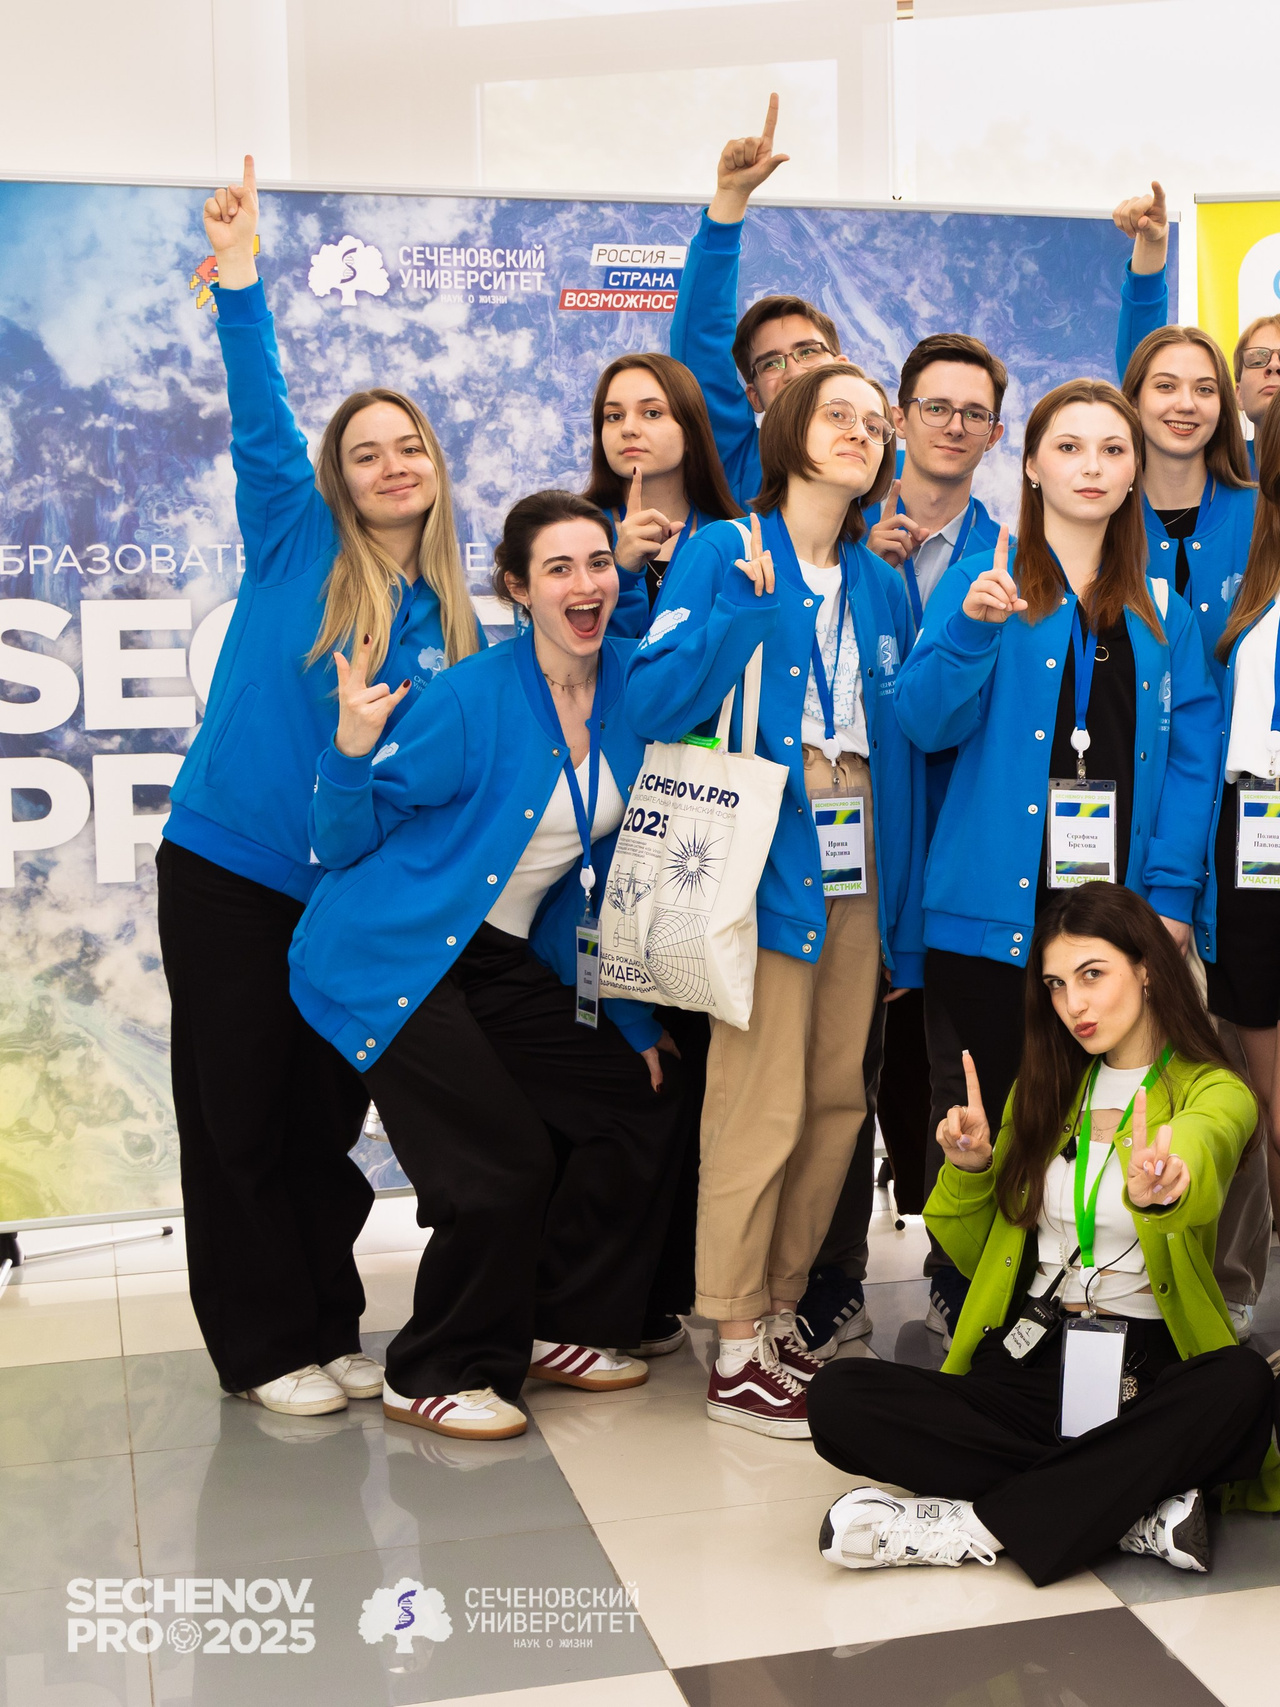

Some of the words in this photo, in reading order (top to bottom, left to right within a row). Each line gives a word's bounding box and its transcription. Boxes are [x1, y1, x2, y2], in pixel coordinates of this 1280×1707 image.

[398, 245, 546, 269] СЕЧЕНОВСКИЙ
[596, 249, 666, 264] РОССИЯ
[398, 269, 546, 292] УНИВЕРСИТЕТ
[608, 271, 675, 288] СТРАНА
[441, 294, 464, 304] НАУК
[468, 295, 475, 304] О
[479, 295, 508, 304] ЖИЗНИ
[564, 292, 678, 309] ВОЗМОЖНОС
[0, 543, 246, 575] БРАЗОВАТЕ
[623, 807, 670, 839] 2025
[823, 882, 863, 893] ЧАСТНИК
[600, 962, 652, 984] ЛИДЕРЫ
